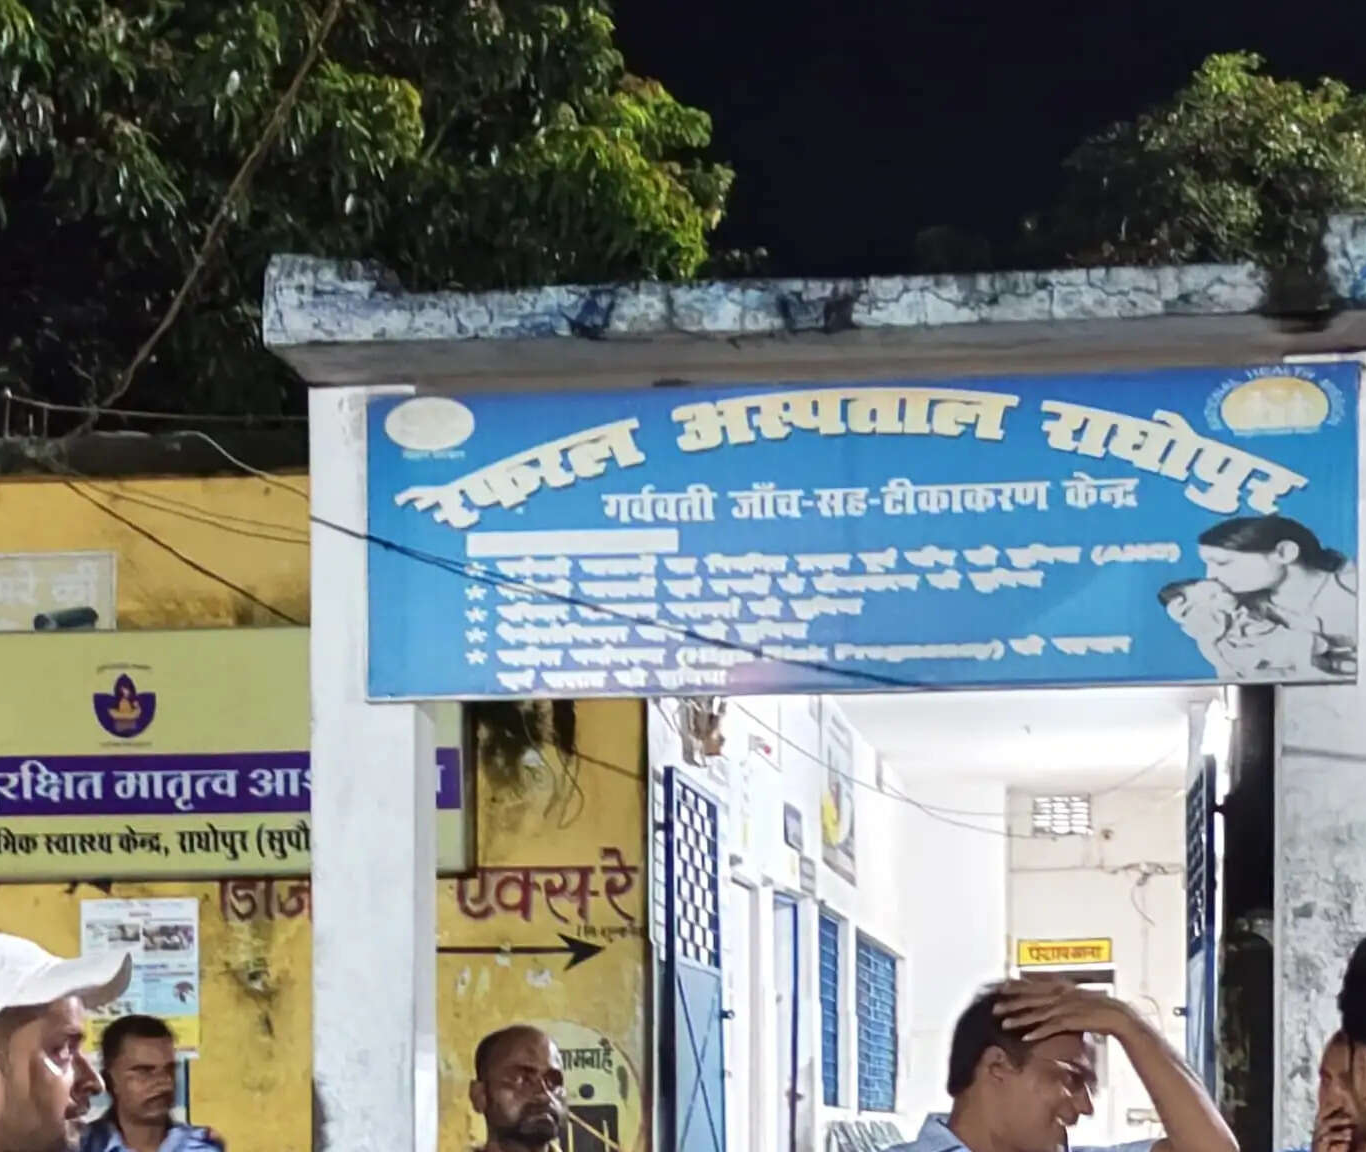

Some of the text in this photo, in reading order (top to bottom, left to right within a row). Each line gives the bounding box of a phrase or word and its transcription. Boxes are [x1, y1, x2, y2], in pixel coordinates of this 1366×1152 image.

[671, 386, 1019, 452] अस्पताल
[1040, 399, 1309, 515] राघोपुर
[114, 768, 238, 811] मातृत्व
[176, 822, 249, 861] राघोपुर
[255, 819, 311, 860] (सुपौ
